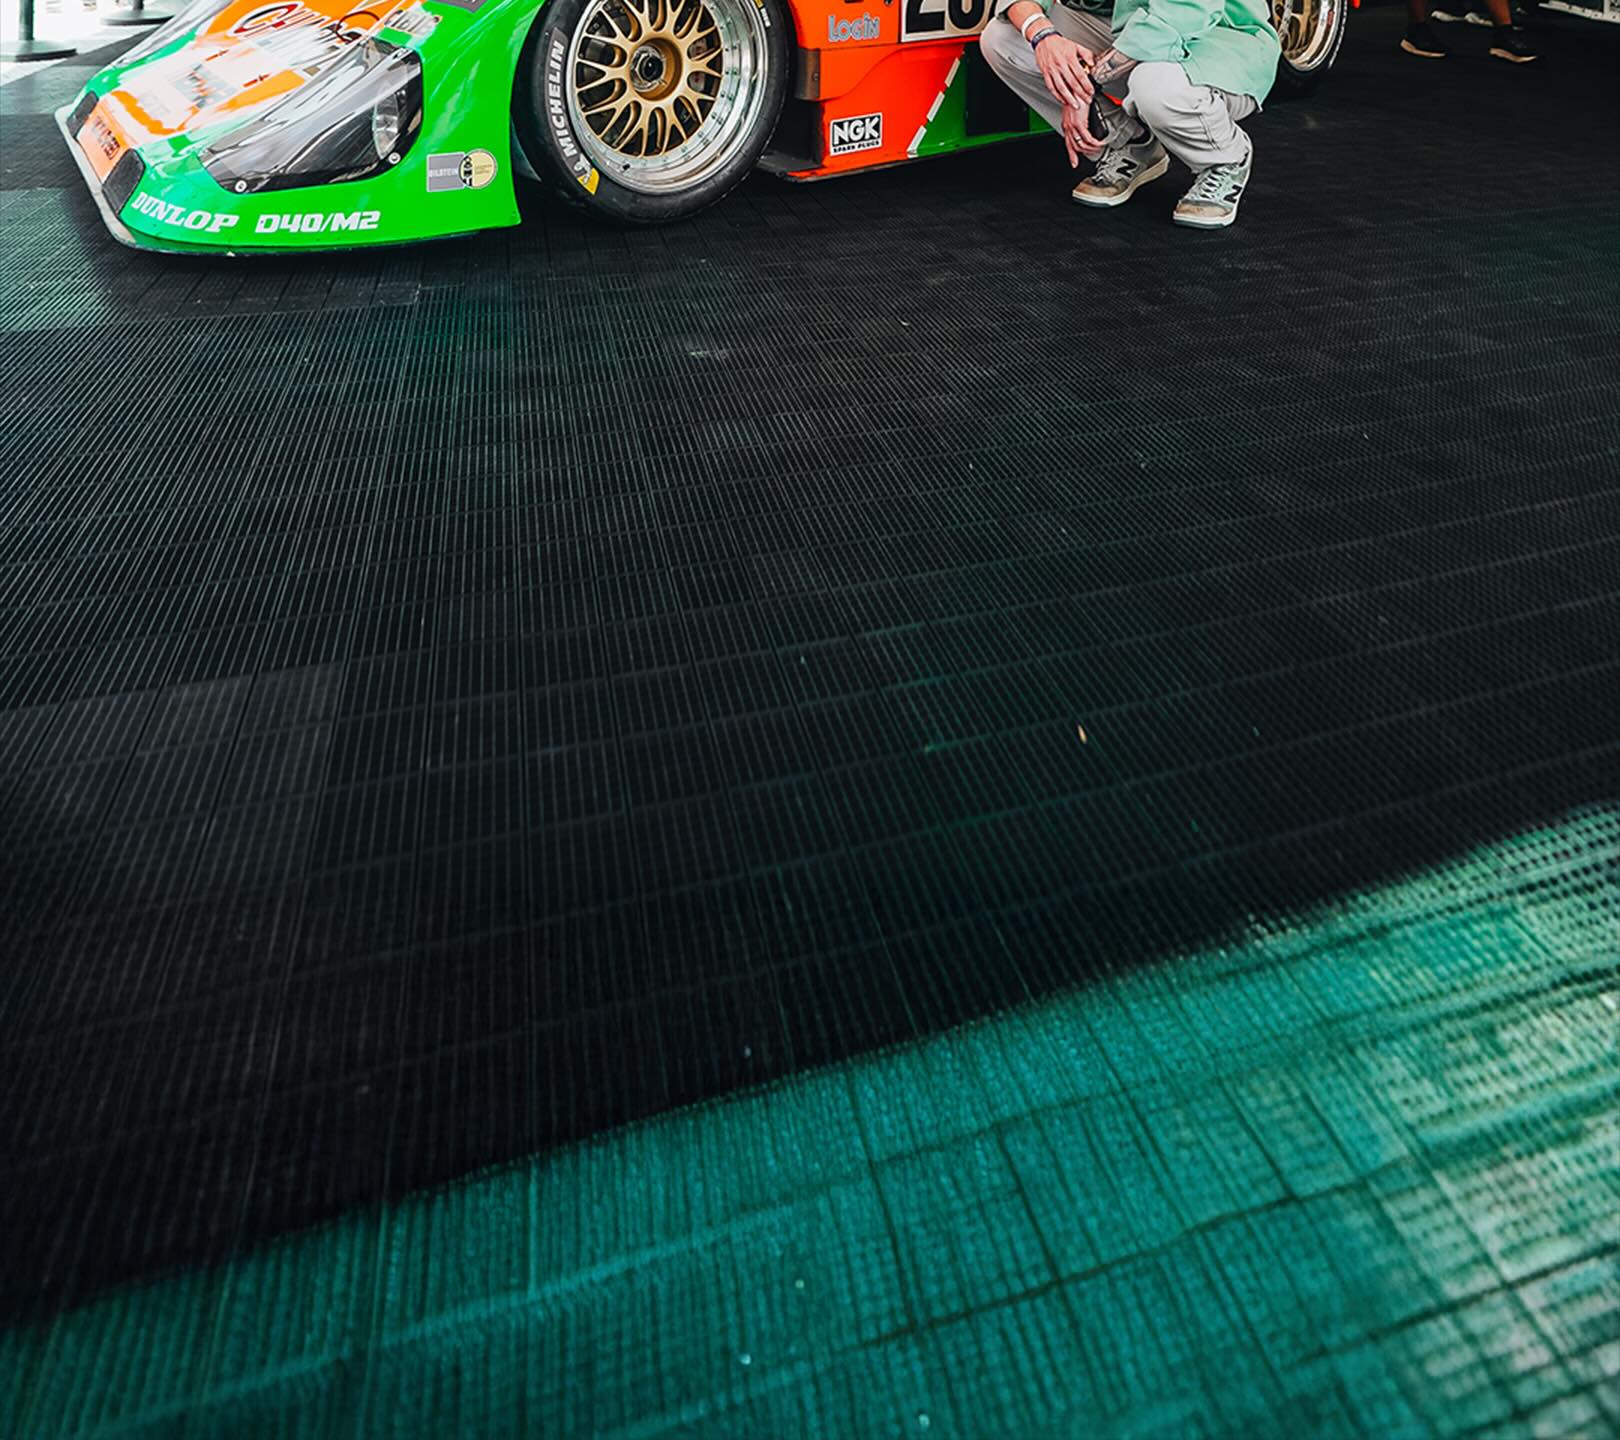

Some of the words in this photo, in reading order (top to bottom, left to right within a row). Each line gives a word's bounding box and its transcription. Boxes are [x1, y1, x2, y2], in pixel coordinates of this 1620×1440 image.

[548, 40, 578, 157] MICHELIN
[833, 116, 879, 145] NGK
[130, 191, 240, 233] DUNLOP
[255, 210, 381, 234] D40/M2
